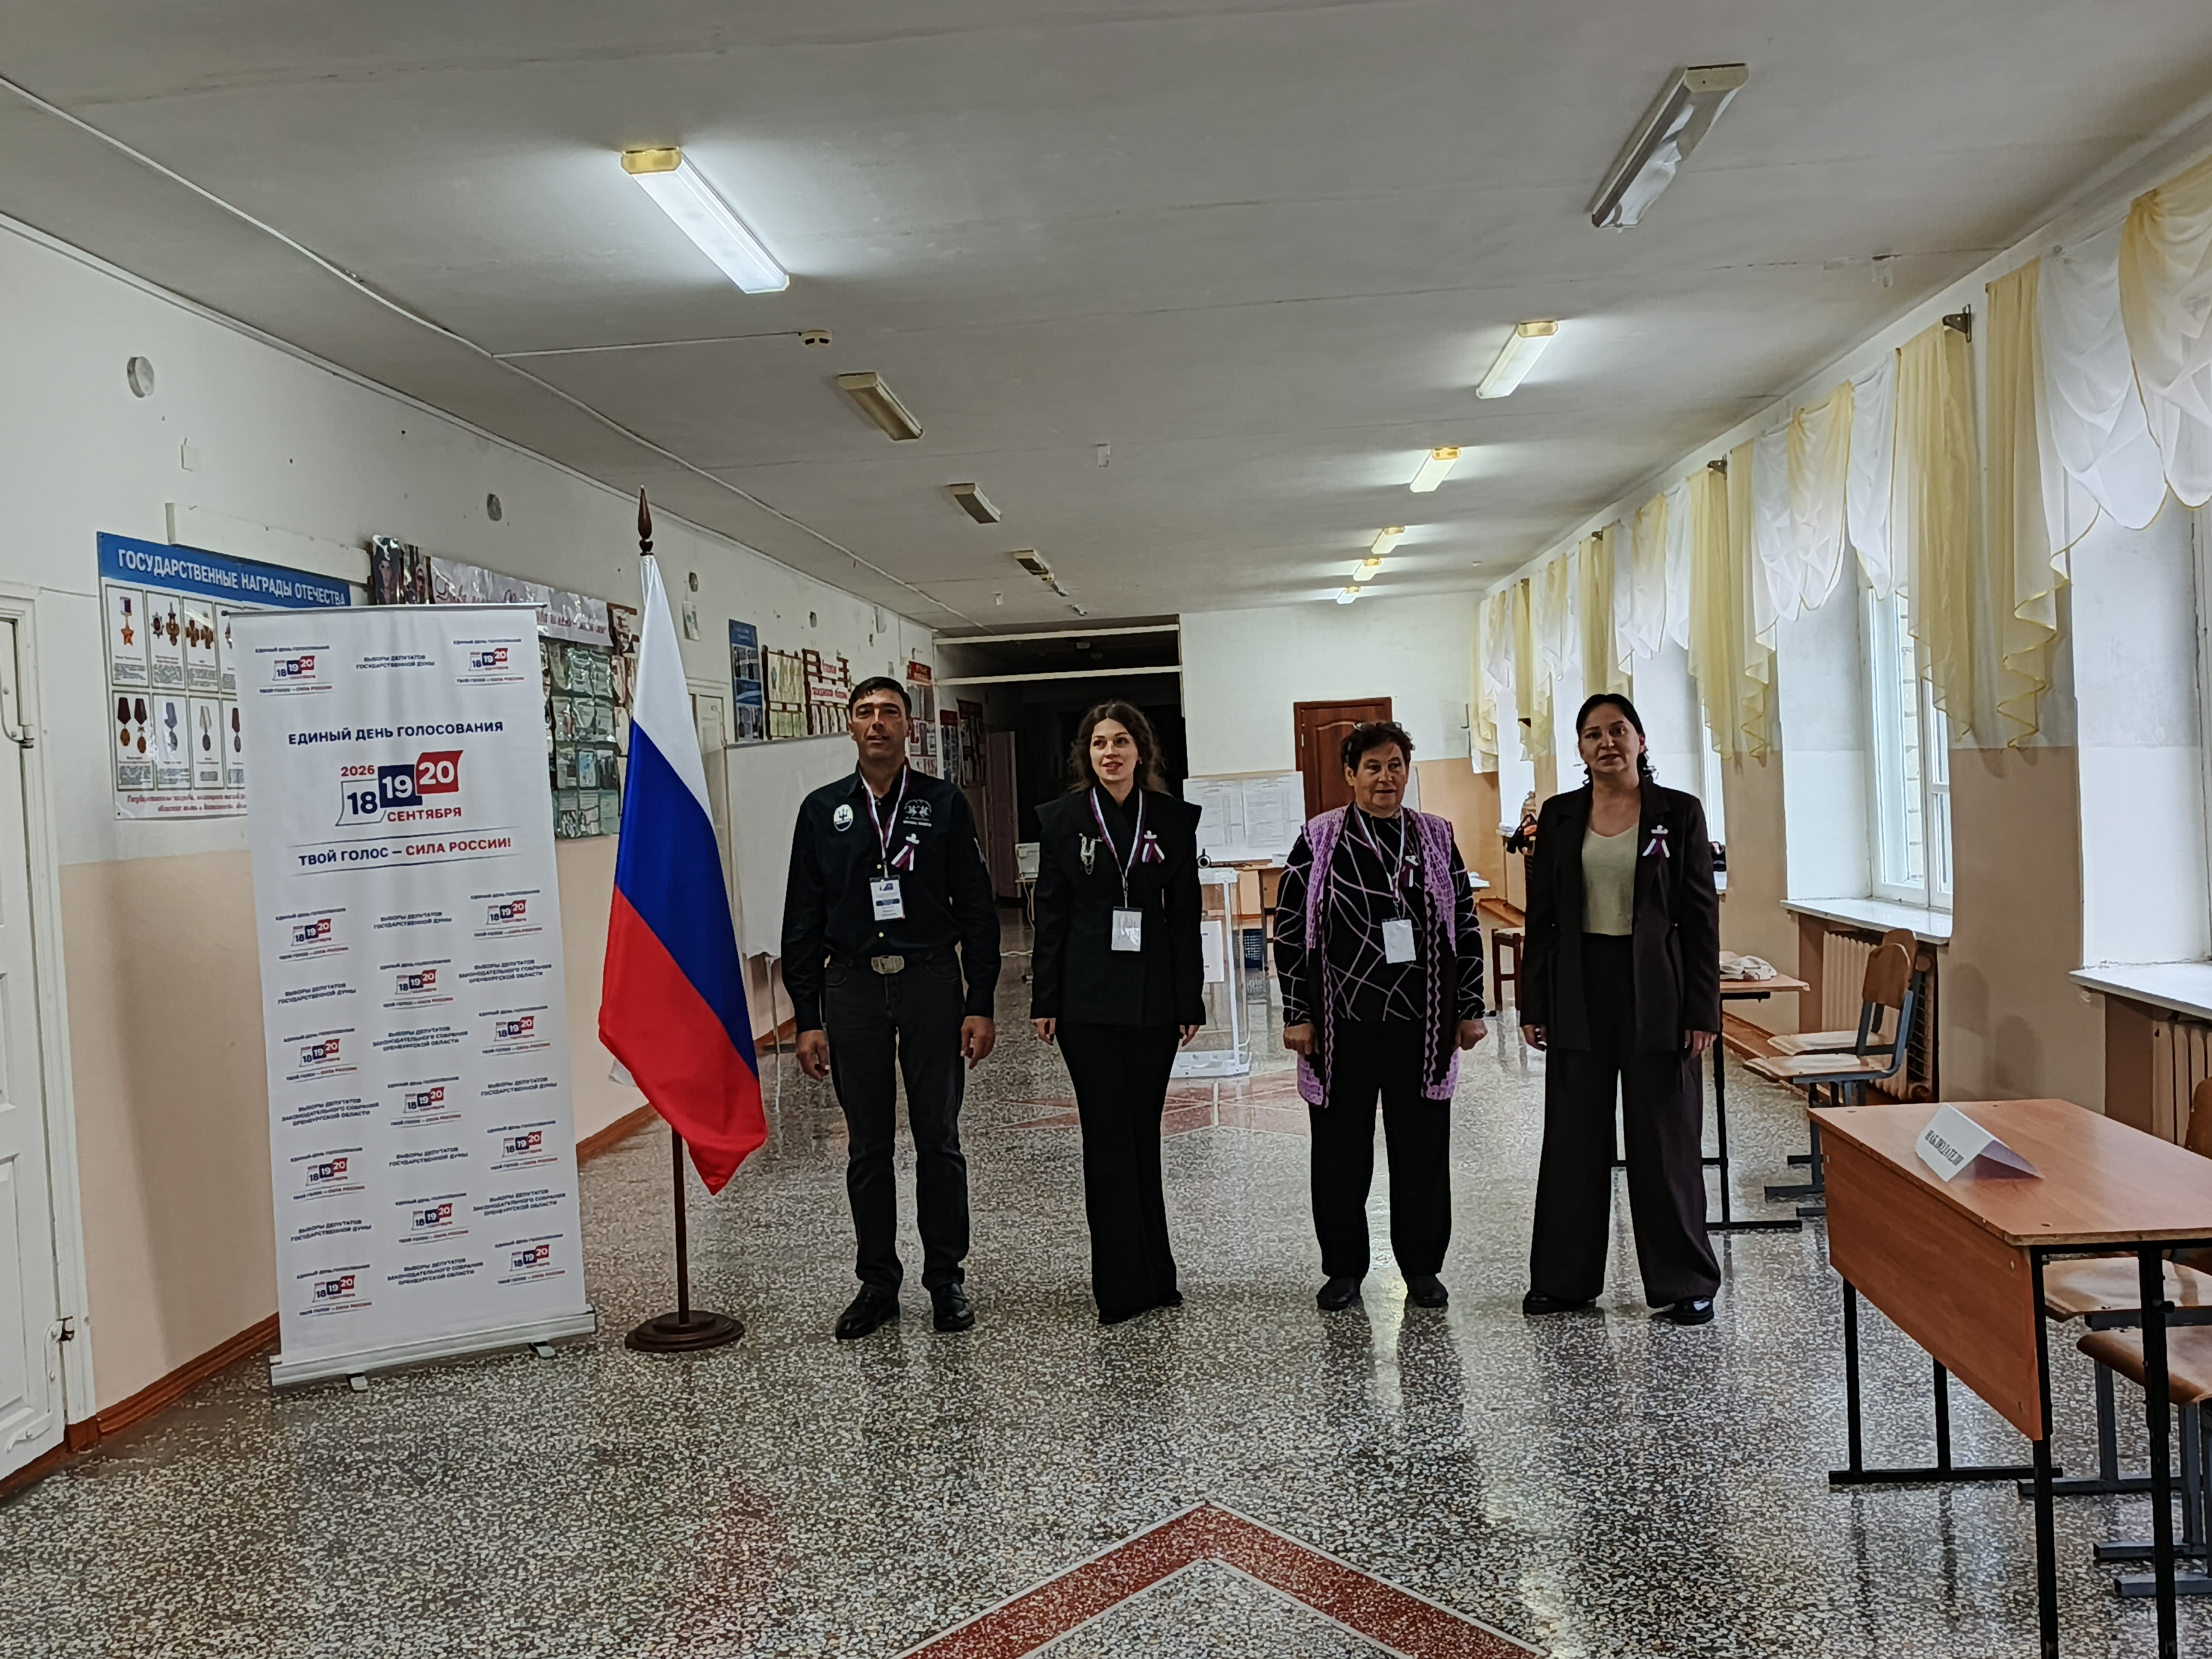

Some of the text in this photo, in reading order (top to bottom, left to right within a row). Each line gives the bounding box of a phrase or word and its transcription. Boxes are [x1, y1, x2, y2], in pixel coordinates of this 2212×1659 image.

[118, 549, 346, 606] ГОСУДАРСТВЕННЫЕ НАГРАДЫ ОТЕЧЕСТВА
[494, 651, 506, 659] 20
[289, 721, 503, 745] ЕДИНЫЙ ДЕНЬ ГОЛОСОВАНИЯ
[341, 765, 375, 777] 2026
[347, 761, 455, 814] 18 19 20
[387, 807, 462, 822] СЕНТЯБРЯ
[298, 849, 337, 866] ТВОЙ
[341, 847, 389, 861] ГОЛОС
[405, 842, 445, 856] СИЛА
[449, 837, 511, 852] РОССИИ!
[489, 913, 499, 922] 18
[295, 934, 305, 942] 18
[317, 922, 329, 931] 20
[399, 983, 409, 991] 18
[423, 973, 435, 981] 20
[521, 1019, 532, 1027] 20
[326, 1042, 337, 1051] 20
[430, 1090, 442, 1099] 20
[528, 1134, 540, 1143] 20
[309, 1161, 345, 1182] 18 19 20
[438, 1207, 450, 1215] 20
[316, 1289, 326, 1298] 18
[341, 1278, 352, 1287] 20
